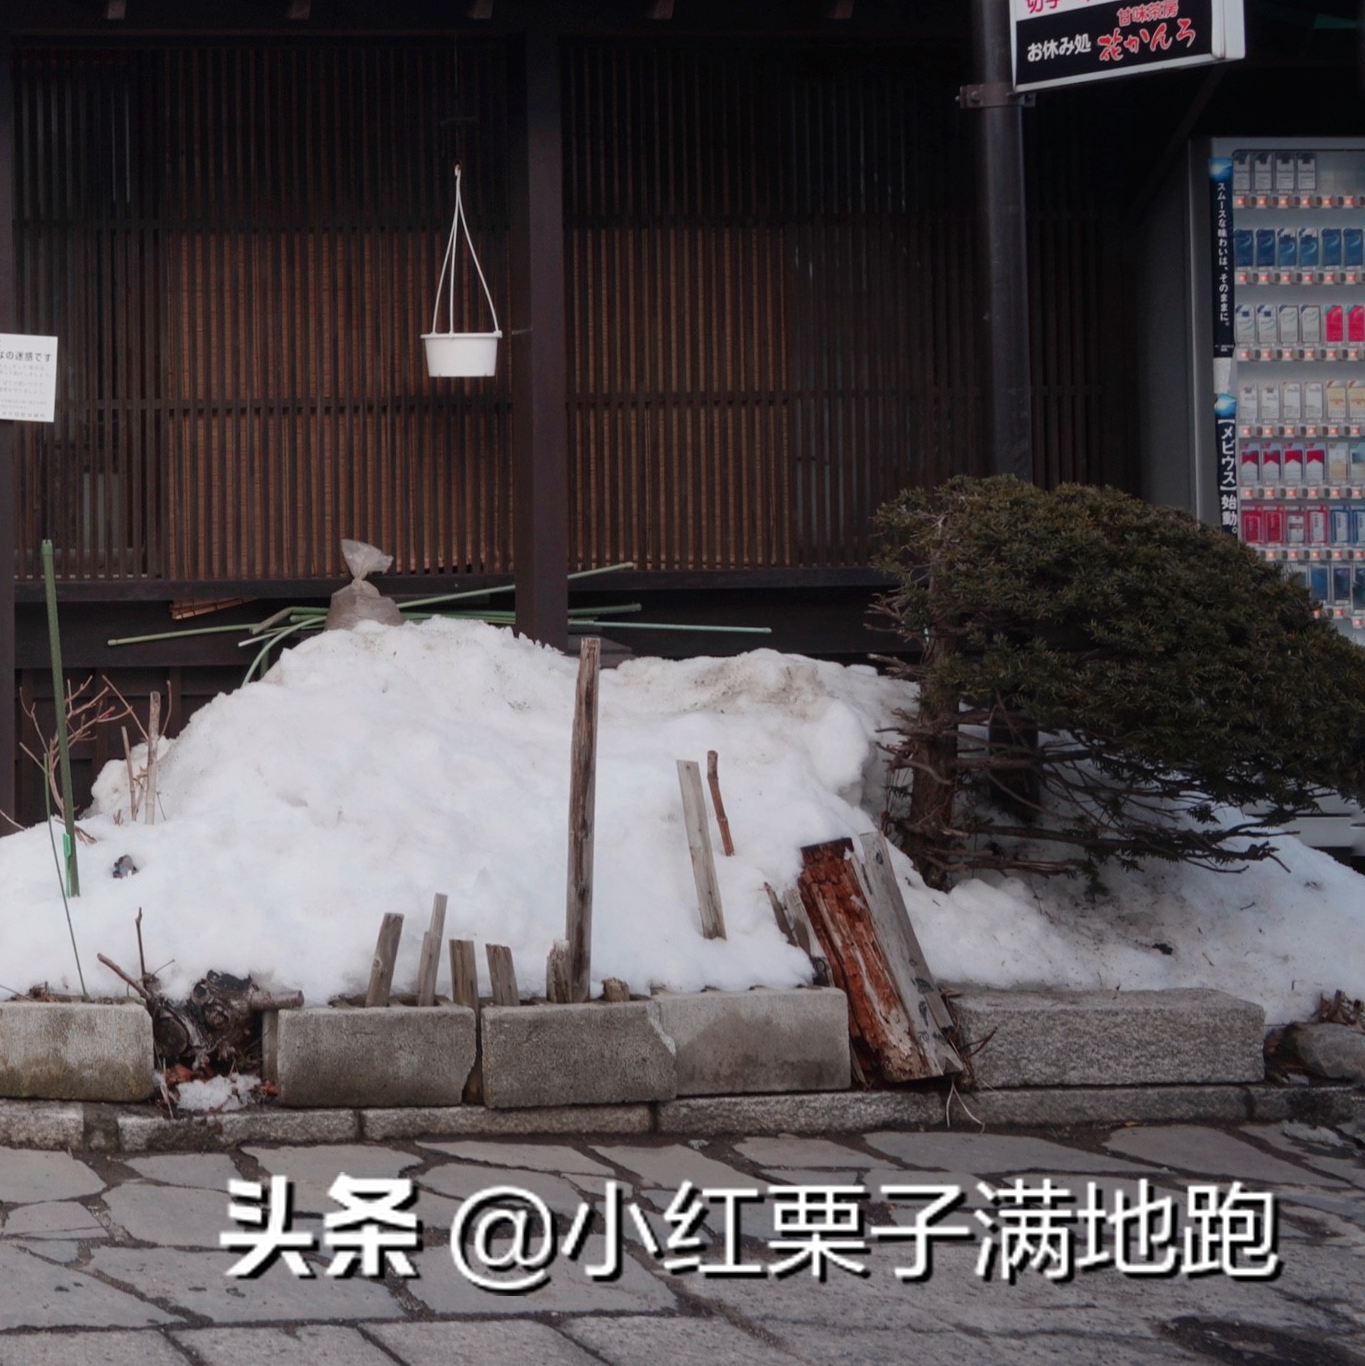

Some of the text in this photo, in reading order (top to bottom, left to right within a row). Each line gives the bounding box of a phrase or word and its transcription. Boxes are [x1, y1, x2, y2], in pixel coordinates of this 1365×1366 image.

[1027, 32, 1092, 63] お休み処
[1097, 16, 1196, 62] 花かんろ
[1217, 182, 1230, 327] スムースな味わいは、そのままに。
[1217, 418, 1238, 534] 【メビウス】始動。
